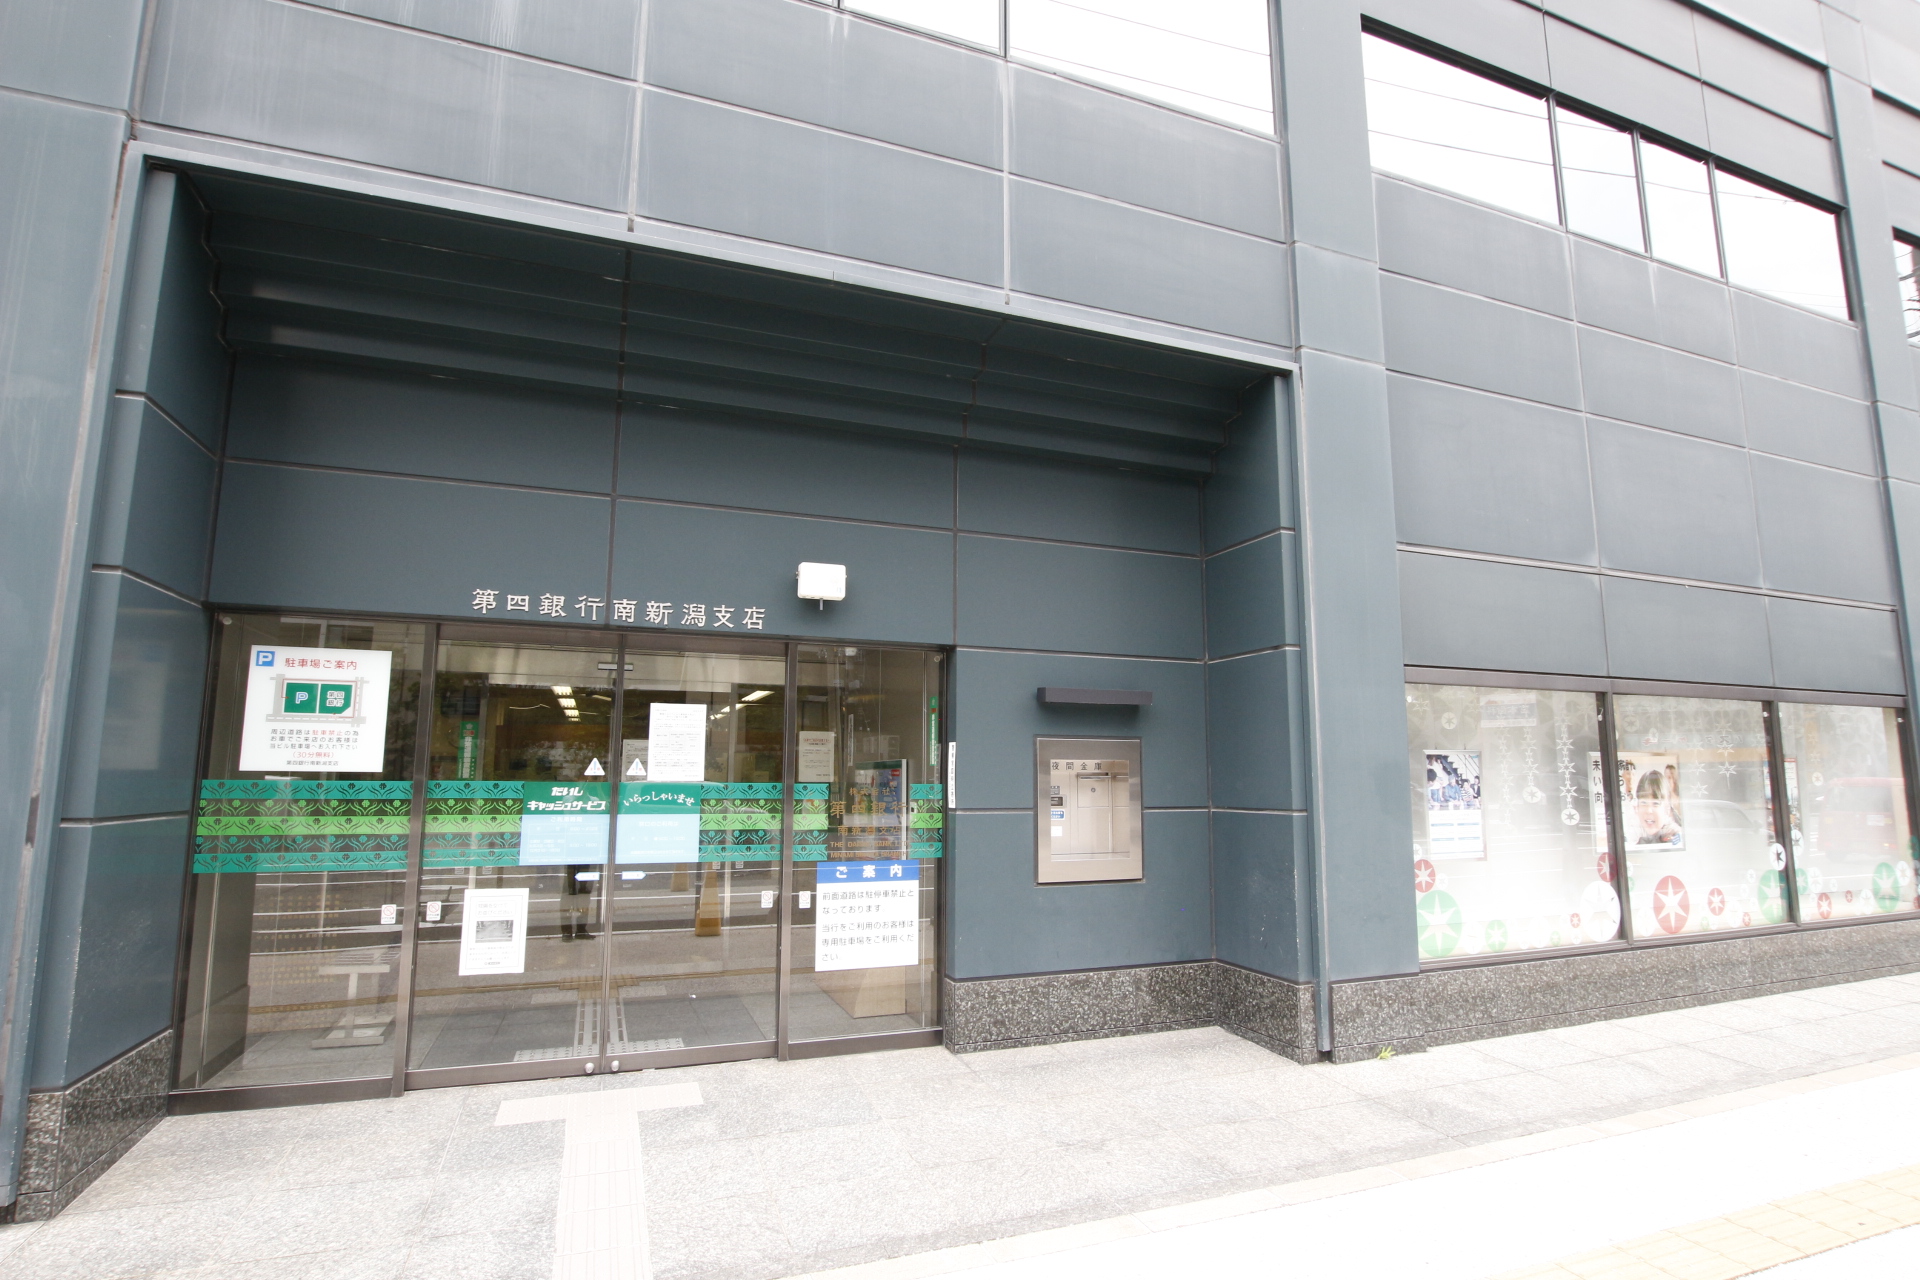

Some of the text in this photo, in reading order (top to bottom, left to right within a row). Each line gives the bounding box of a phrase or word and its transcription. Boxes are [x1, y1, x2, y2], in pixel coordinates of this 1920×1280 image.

[471, 588, 766, 630] 第四銀行南新潟支店
[284, 657, 358, 671] 駐車場ご案内
[270, 728, 359, 737] 周辺道路は駐車禁止の為
[551, 786, 583, 797] だいし
[527, 800, 606, 811] キャッシュサービス
[623, 791, 695, 807] いらっしゃいませ
[830, 801, 908, 818] 第四銀行
[836, 864, 902, 878] ご案内
[822, 889, 914, 901] 前面道路は駐停車禁止と
[822, 920, 914, 932] 当行をご利用のお客様は
[822, 934, 914, 947] 専用駐車場をご利用くだ
